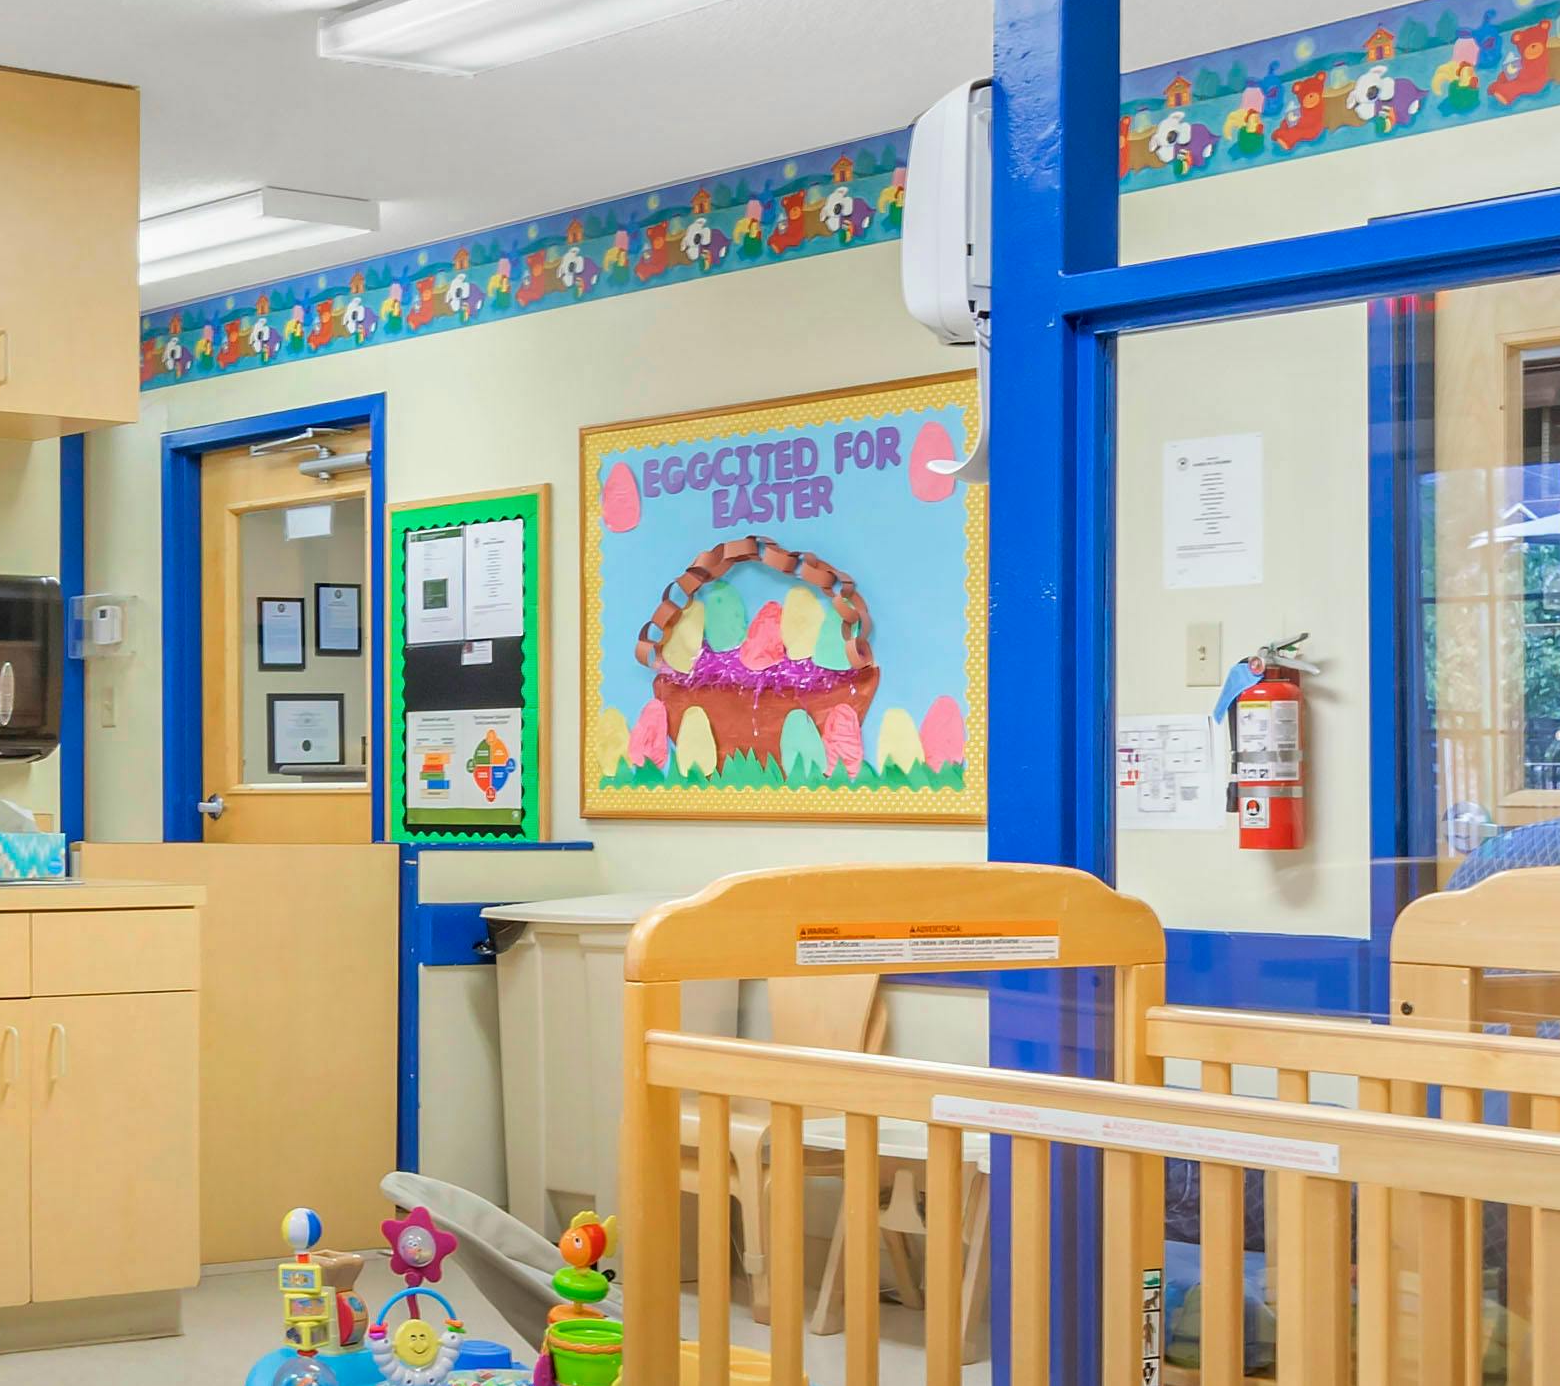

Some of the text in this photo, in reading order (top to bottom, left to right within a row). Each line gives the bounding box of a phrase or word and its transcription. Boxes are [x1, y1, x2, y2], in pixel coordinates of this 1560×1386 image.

[642, 426, 901, 498] EGGCITED FOR
[712, 476, 834, 529] EASTER
